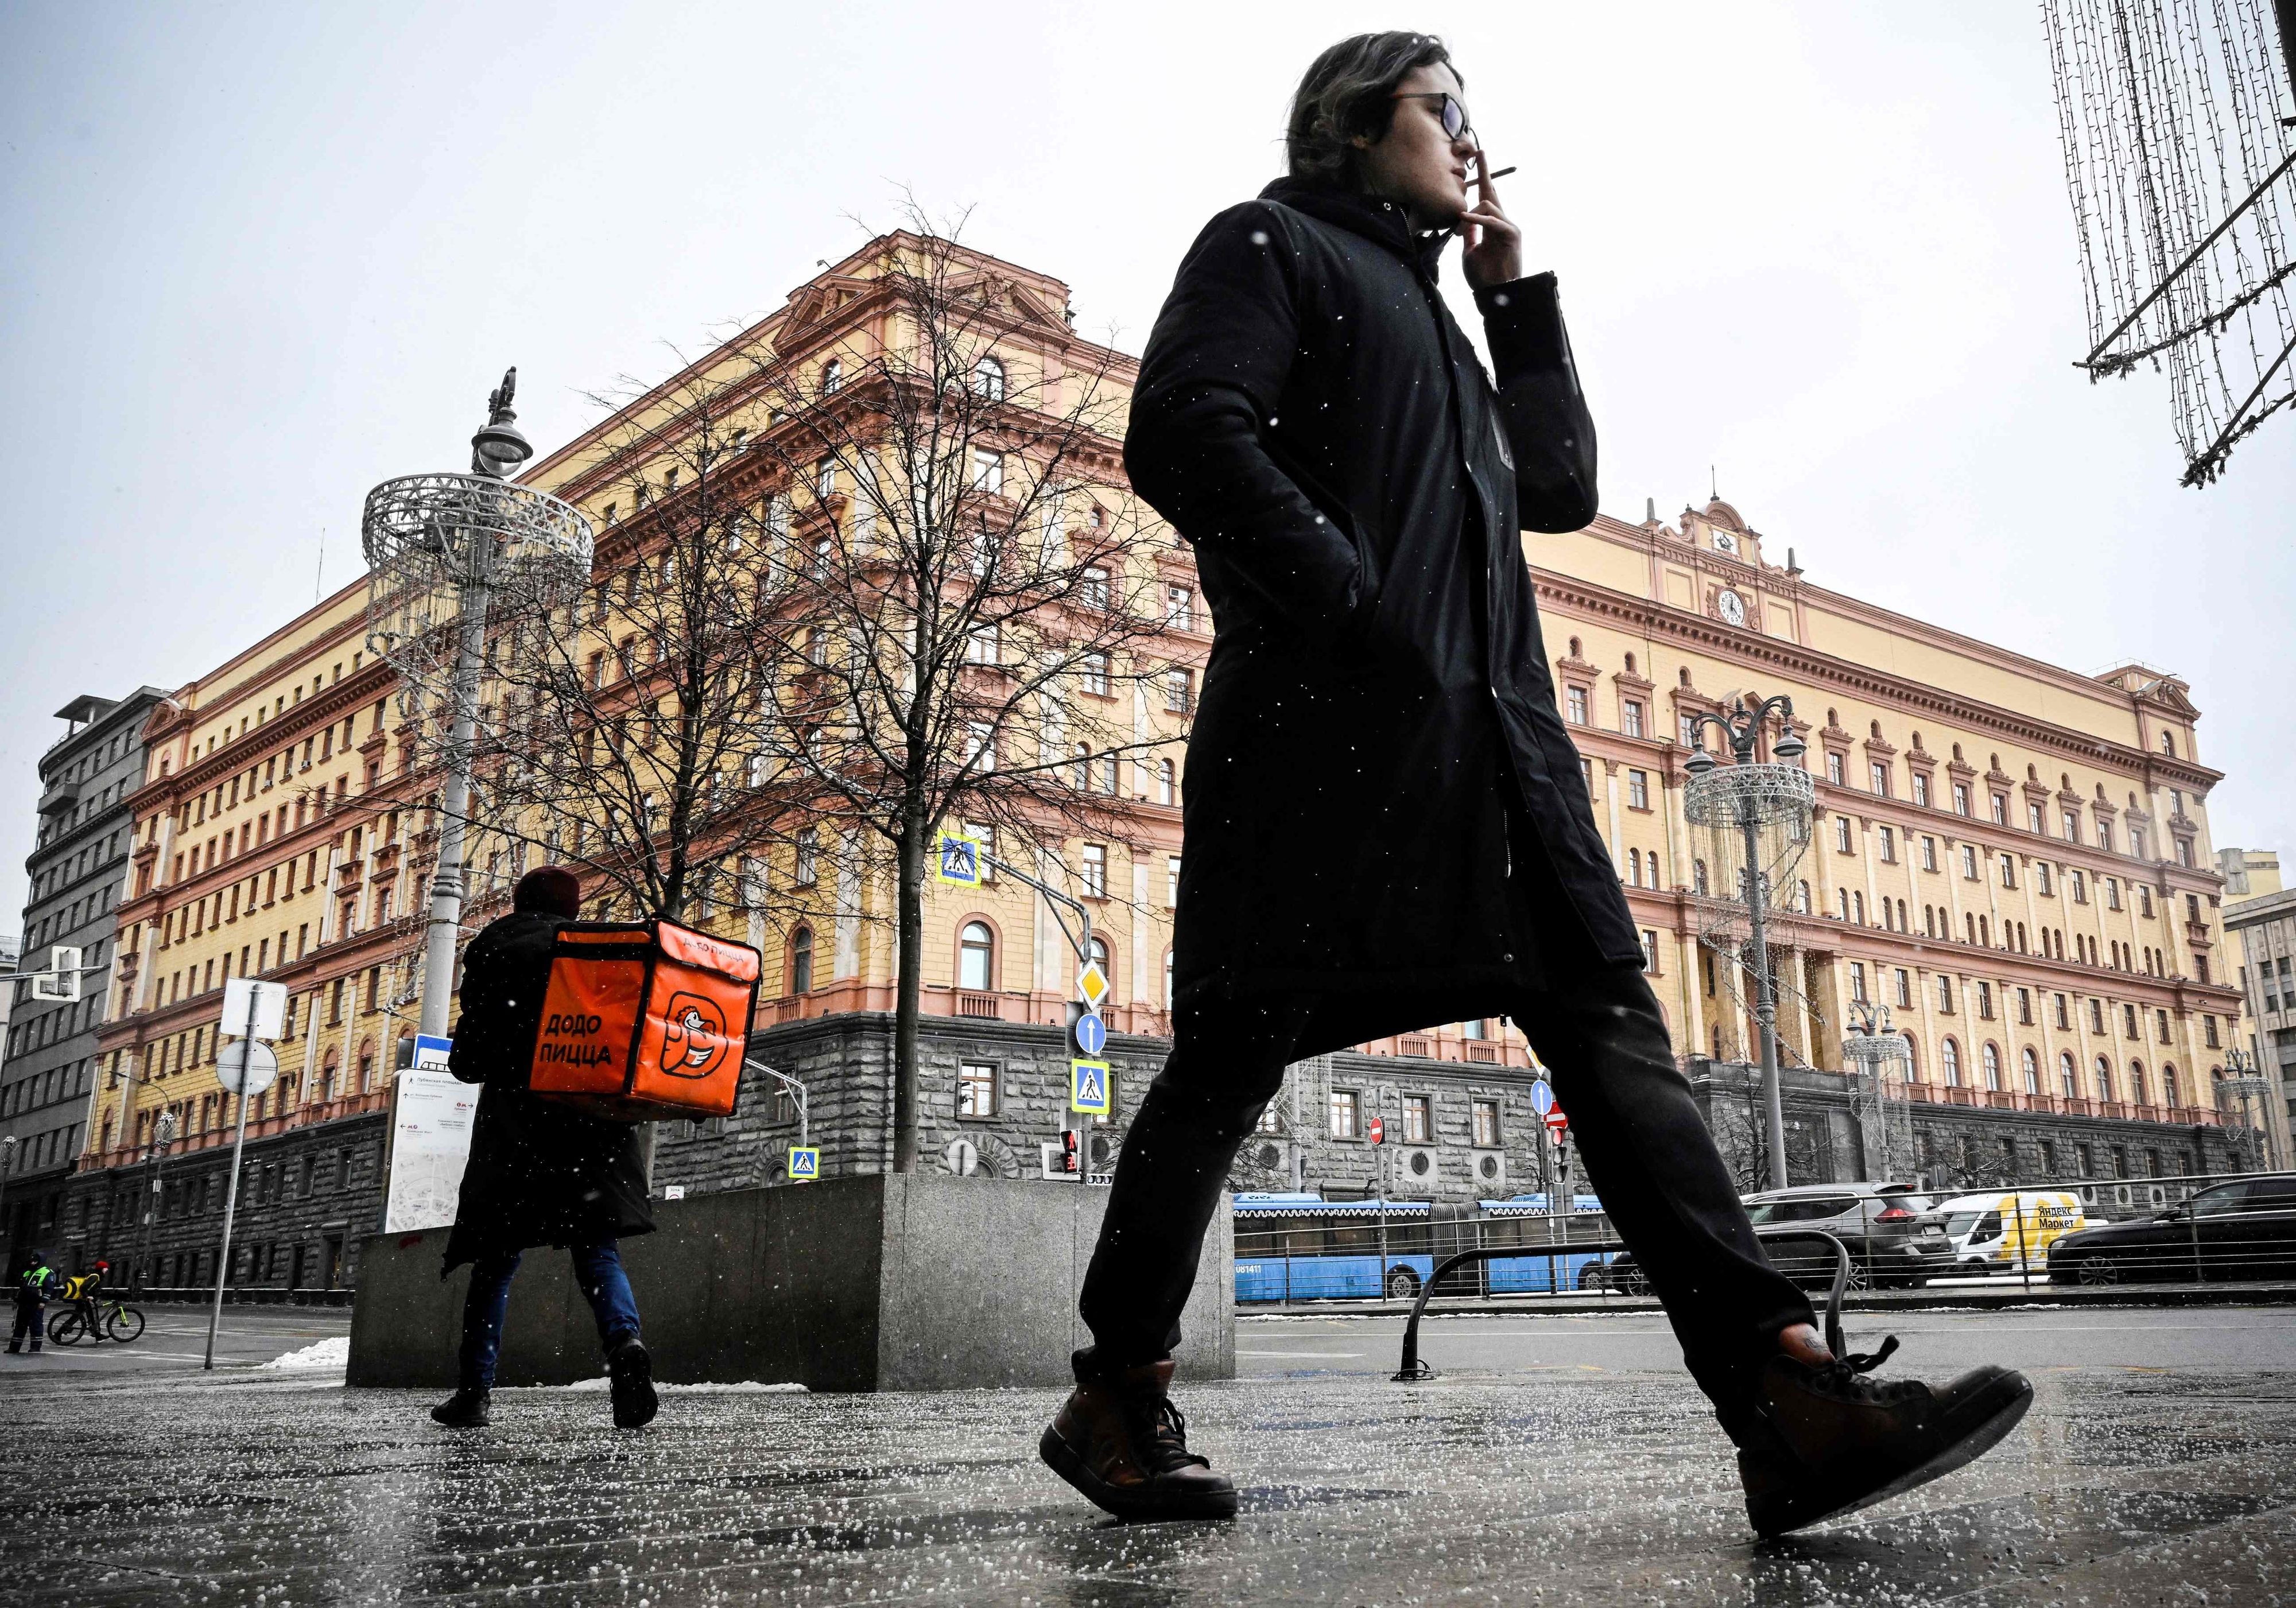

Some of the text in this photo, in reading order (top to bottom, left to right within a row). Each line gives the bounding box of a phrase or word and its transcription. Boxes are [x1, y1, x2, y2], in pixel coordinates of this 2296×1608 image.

[711, 945, 744, 963] ПИЦЦА
[544, 1014, 602, 1038] ДОДО
[540, 1043, 612, 1068] ПИЦЦА
[2038, 1206, 2072, 1218] Яндекс
[2038, 1218, 2074, 1230] Маркет
[1235, 1264, 1262, 1273] 081411
